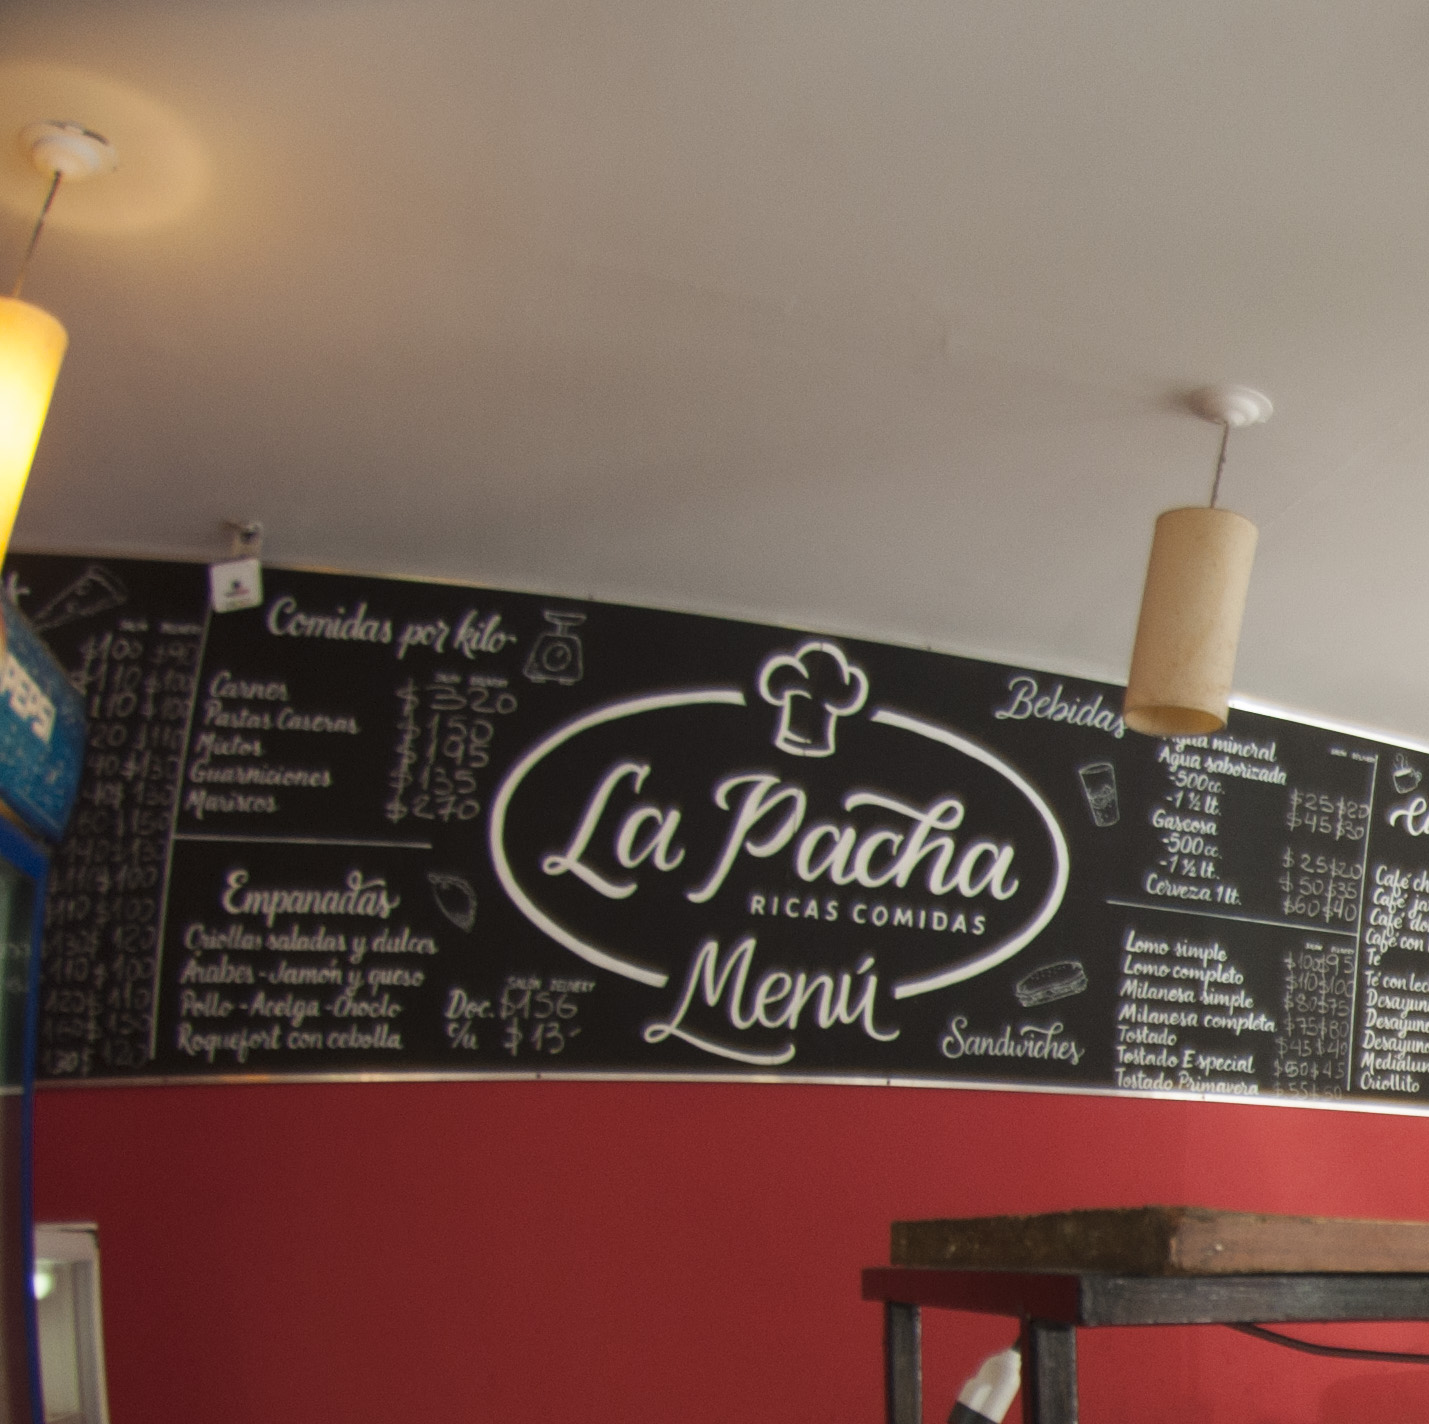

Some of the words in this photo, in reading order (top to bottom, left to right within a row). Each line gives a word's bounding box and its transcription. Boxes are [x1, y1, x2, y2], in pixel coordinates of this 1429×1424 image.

[265, 595, 392, 644] Comidas
[396, 619, 449, 660] por
[209, 670, 290, 702] Carnes
[203, 699, 272, 730] Pastas
[276, 706, 360, 736] Caseras
[994, 675, 1128, 739] Bebidas
[1157, 745, 1202, 773] Agua
[1204, 756, 1288, 785] saborizada
[1212, 736, 1277, 763] mineral
[187, 757, 333, 788] Guarniciones
[1289, 788, 1334, 813] $25
[1335, 796, 1369, 819] $20
[541, 762, 686, 901] La
[686, 774, 1020, 903] Pacha
[1151, 808, 1217, 836] Gaseosa
[1286, 811, 1332, 834] $45
[1282, 844, 1328, 874] $25
[1145, 873, 1213, 902] Cerveza
[1279, 871, 1324, 895] $50
[1325, 879, 1358, 900] $35
[1375, 865, 1412, 899] Café
[221, 868, 401, 928] Empanadas
[1283, 894, 1320, 917] $60
[1322, 897, 1358, 923] $40
[1372, 886, 1409, 914] Café
[749, 895, 839, 925] RICAS
[852, 904, 988, 936] COMIDAS
[1370, 907, 1404, 938] Café
[184, 922, 262, 951] Criollas
[265, 923, 347, 952] saladas
[350, 937, 366, 964] y
[372, 926, 439, 954] dulces
[1125, 929, 1170, 954] Lomo
[1174, 938, 1228, 969] simple
[1365, 928, 1400, 957] Café
[1400, 935, 1424, 953] con
[346, 973, 362, 996] y
[367, 972, 425, 996] queso
[1123, 955, 1171, 978] Lomo
[1173, 963, 1244, 991] completo
[1364, 968, 1381, 988] Té
[1383, 974, 1407, 992] con
[181, 990, 234, 1019] Pollo
[642, 938, 902, 1066] Menú
[1120, 978, 1196, 1004] Milanesa
[1200, 989, 1254, 1016] simple
[1117, 1003, 1199, 1028] Milanesa
[1203, 1012, 1277, 1036] completa
[178, 1022, 281, 1064] Roquefort
[286, 1030, 324, 1050] con
[326, 1022, 404, 1050] cebolla
[941, 1016, 1086, 1066] Sandwiches
[1117, 1025, 1177, 1046] Tostado
[1116, 1045, 1179, 1068] Tostado
[1183, 1049, 1255, 1076] Especial
[1115, 1067, 1173, 1091] Tostado
[1179, 1068, 1260, 1096] Primavera
[1360, 1071, 1421, 1094] Criollito
